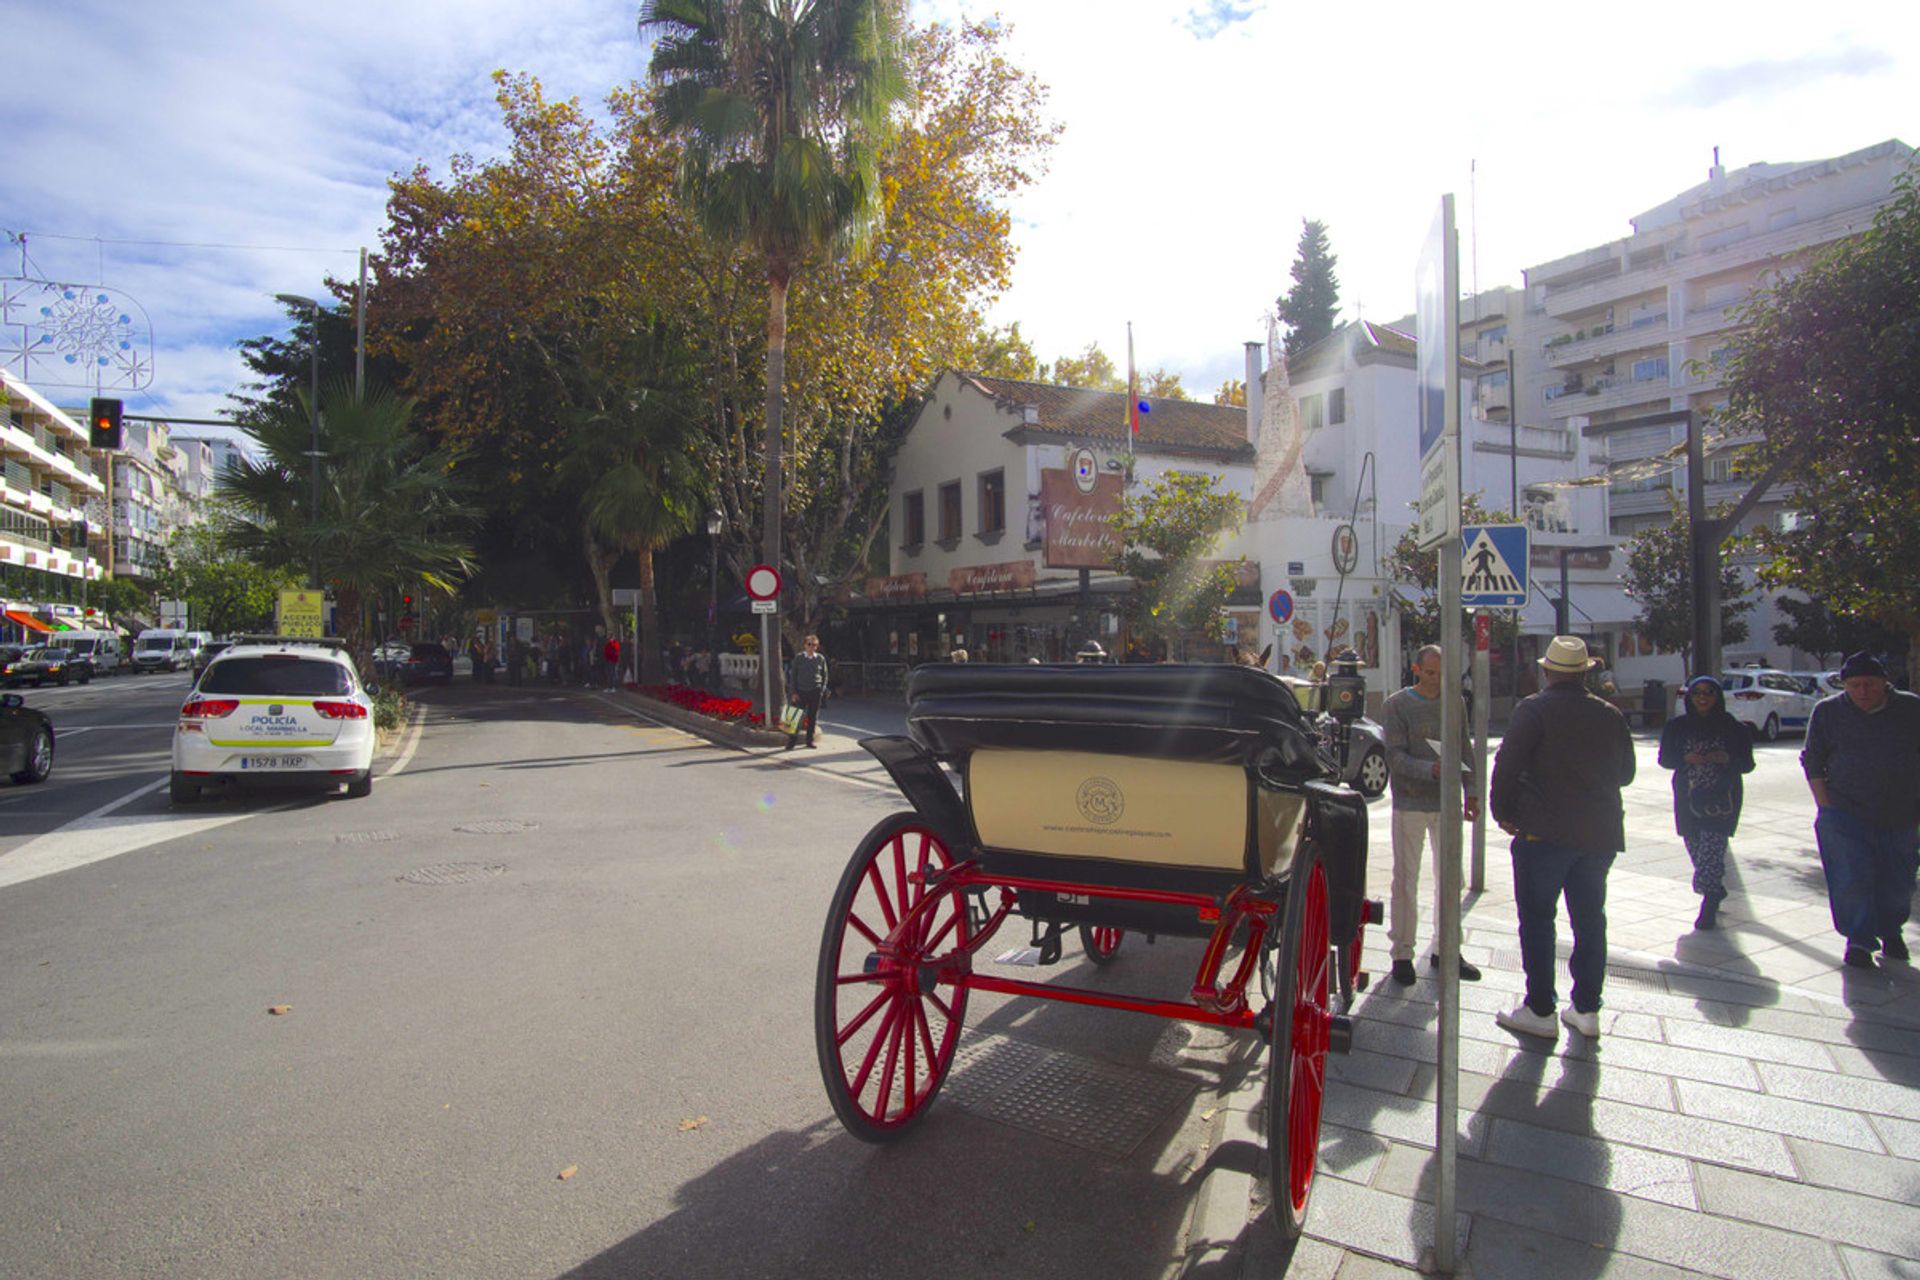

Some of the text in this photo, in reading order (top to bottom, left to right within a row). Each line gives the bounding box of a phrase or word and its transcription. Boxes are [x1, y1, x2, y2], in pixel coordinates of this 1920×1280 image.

[251, 715, 298, 725] POLICÍA
[240, 725, 264, 733] LOCAL
[250, 757, 303, 768] 1578 HXP
